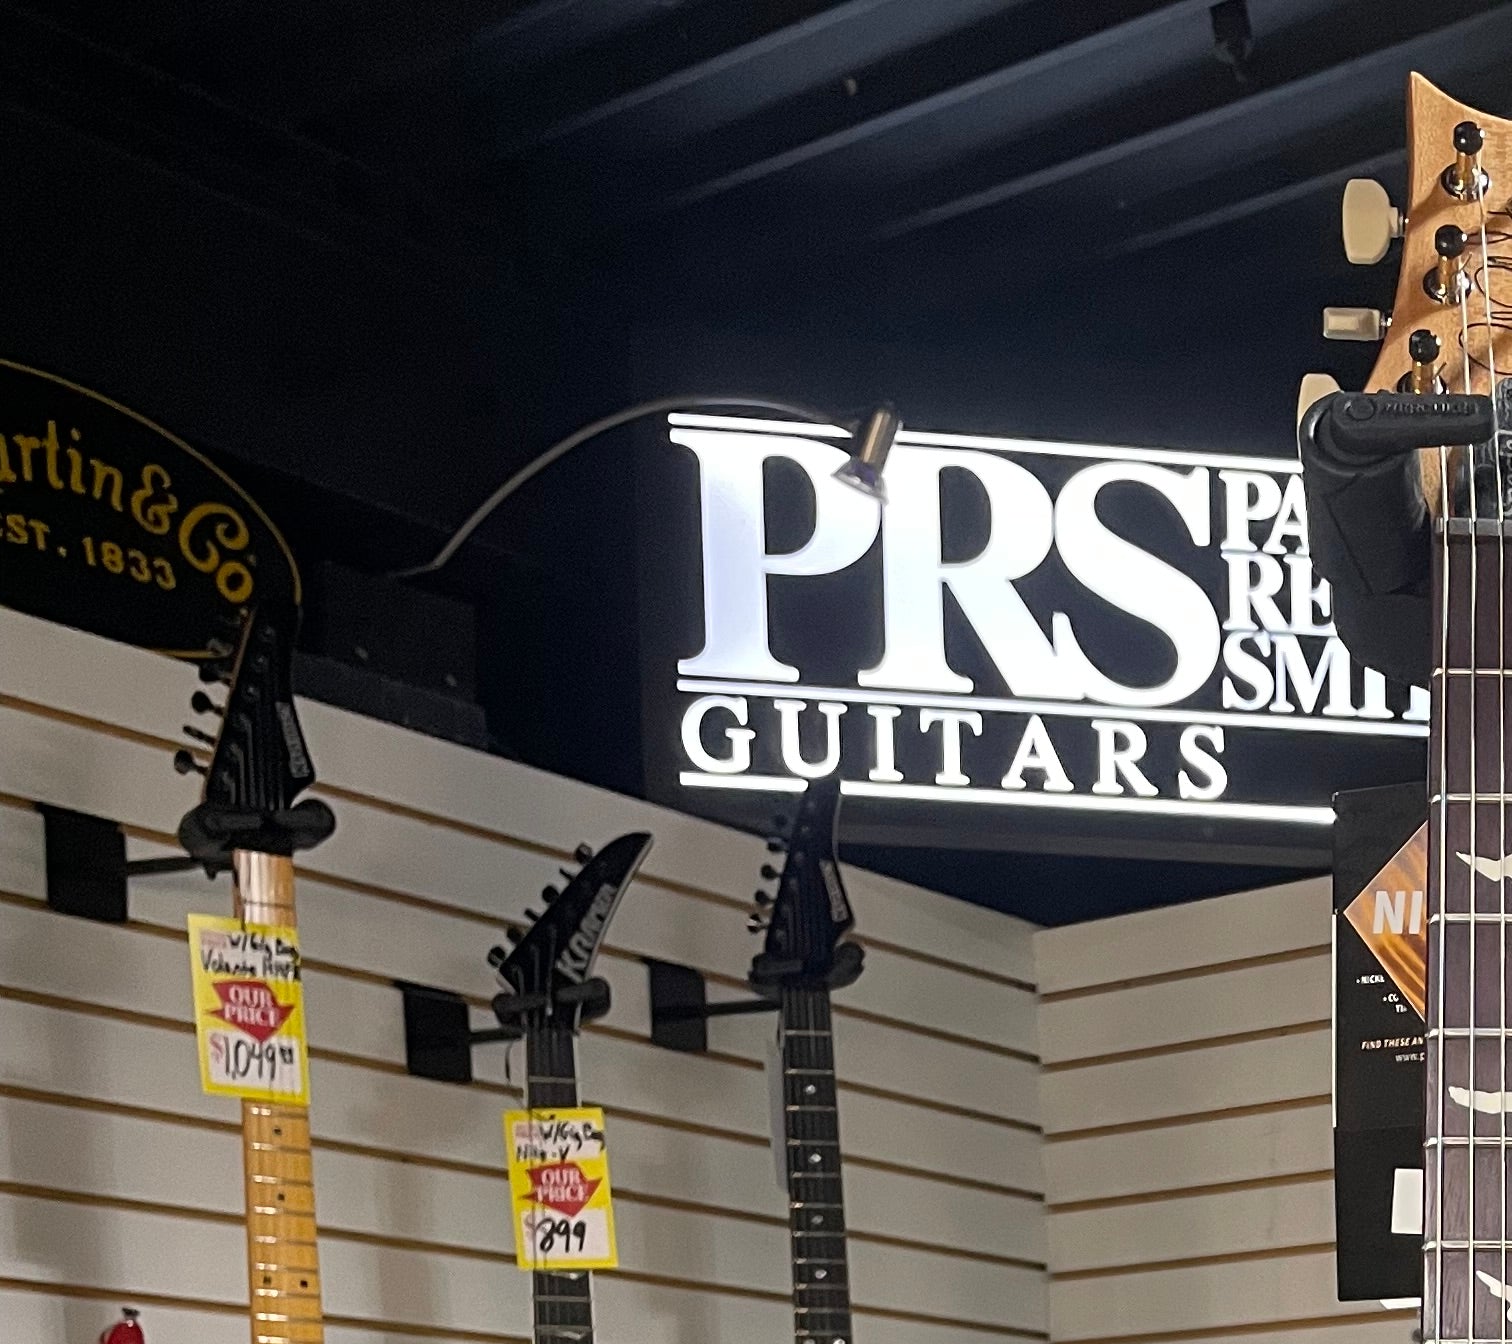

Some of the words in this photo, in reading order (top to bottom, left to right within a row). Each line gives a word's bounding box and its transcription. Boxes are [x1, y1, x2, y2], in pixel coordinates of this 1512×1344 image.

[0, 512, 67, 558] ST.
[81, 536, 177, 591] 1833
[669, 428, 1221, 708] PRS
[680, 693, 1227, 801] GUITARS
